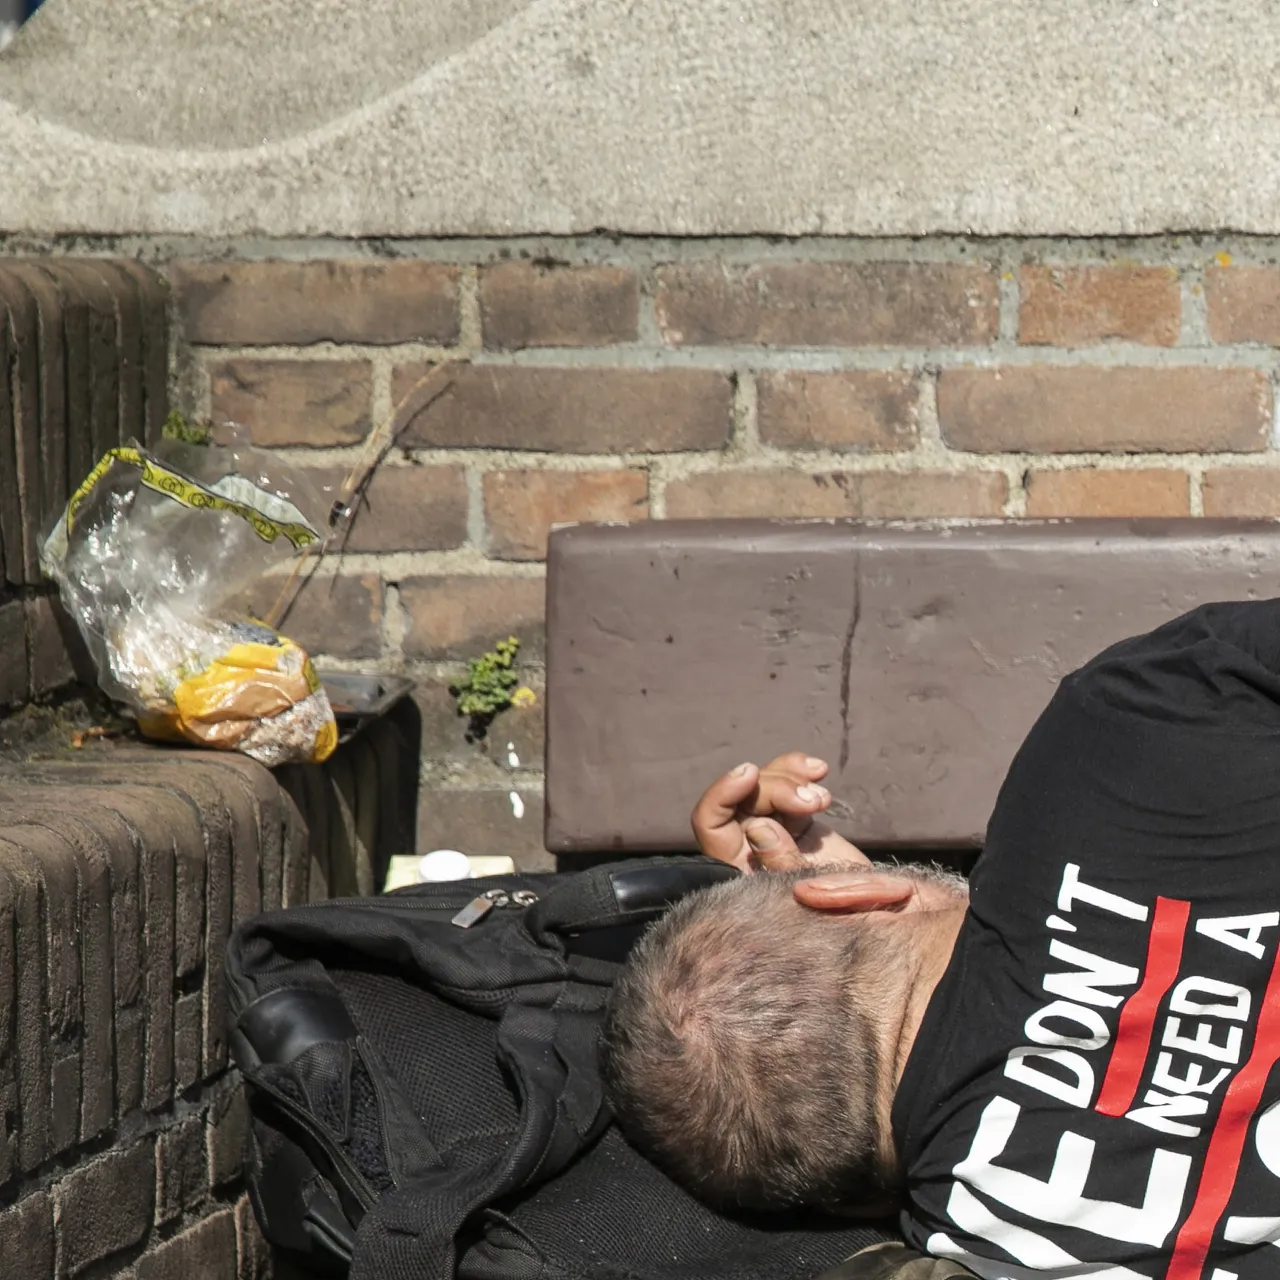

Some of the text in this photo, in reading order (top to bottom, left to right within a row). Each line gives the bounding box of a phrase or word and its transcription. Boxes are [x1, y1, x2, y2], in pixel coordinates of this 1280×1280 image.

[1003, 862, 1149, 1109] DON'T
[1125, 911, 1280, 1138] NEED A
